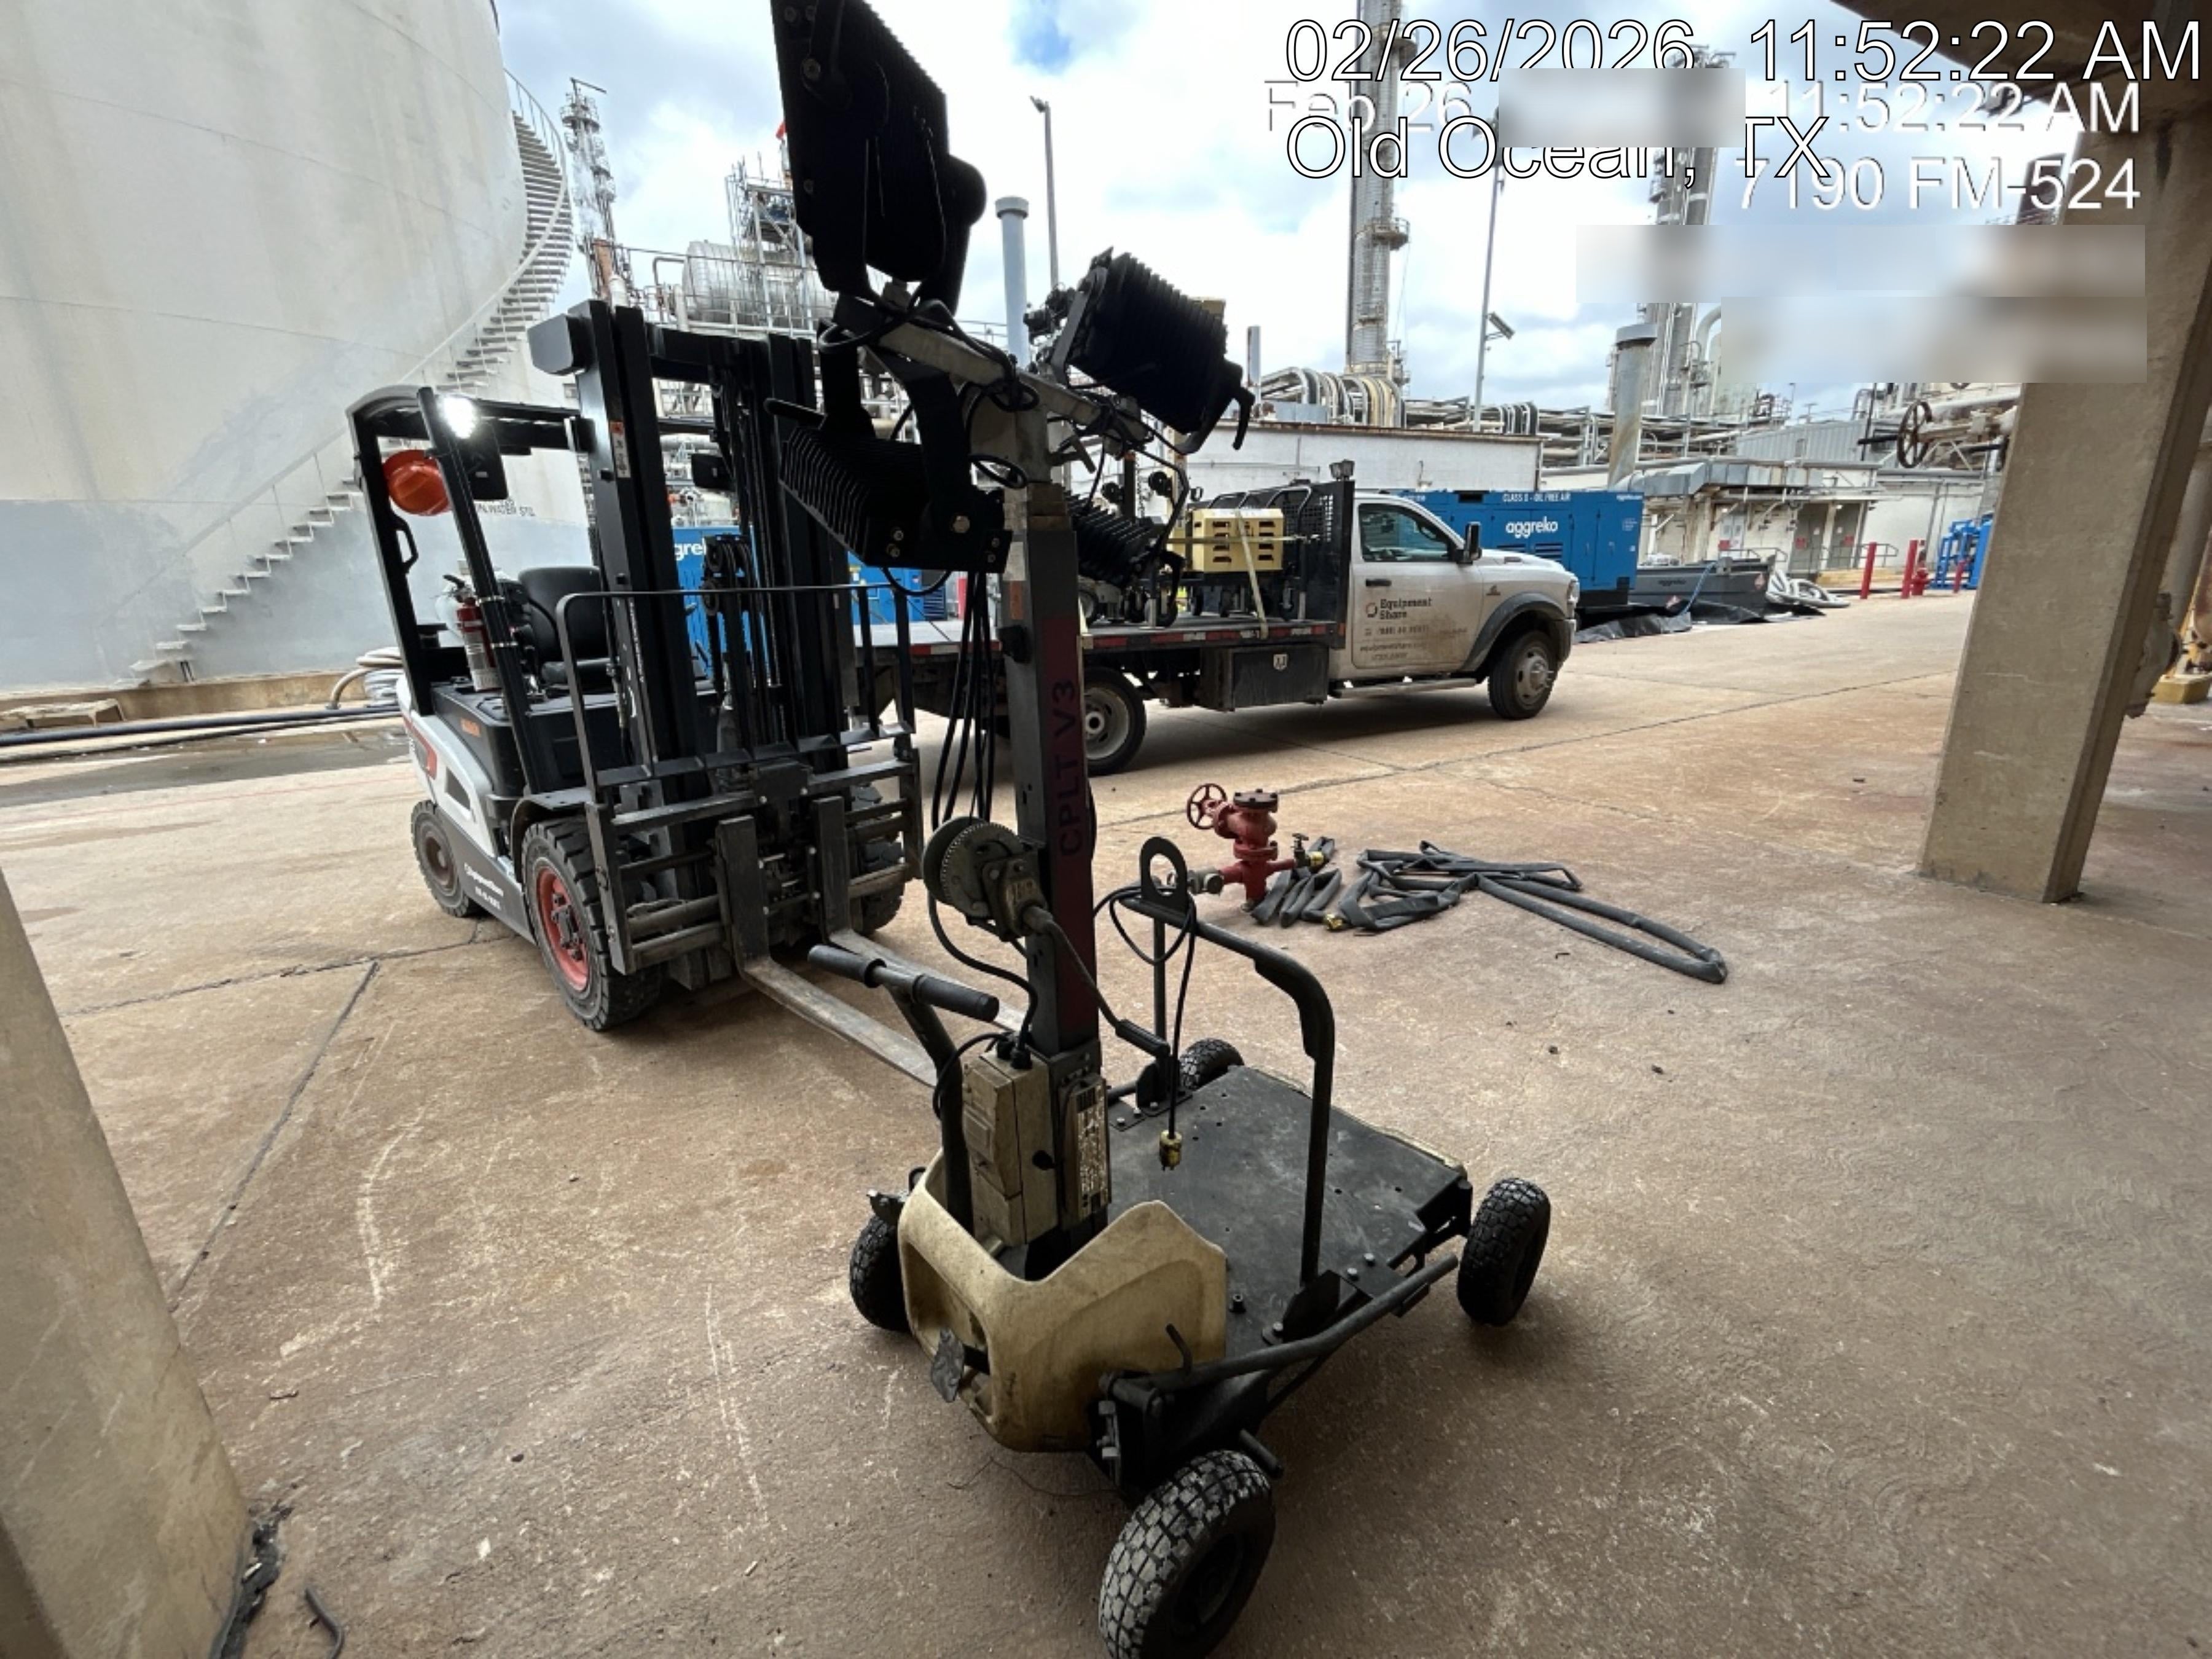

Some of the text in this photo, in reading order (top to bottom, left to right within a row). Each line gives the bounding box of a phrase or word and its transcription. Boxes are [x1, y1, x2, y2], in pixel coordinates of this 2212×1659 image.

[1505, 516, 1559, 538] aggreko
[1380, 597, 1433, 610] Equipment
[1380, 610, 1407, 620] Share
[1053, 679, 1082, 855] CPLT V3
